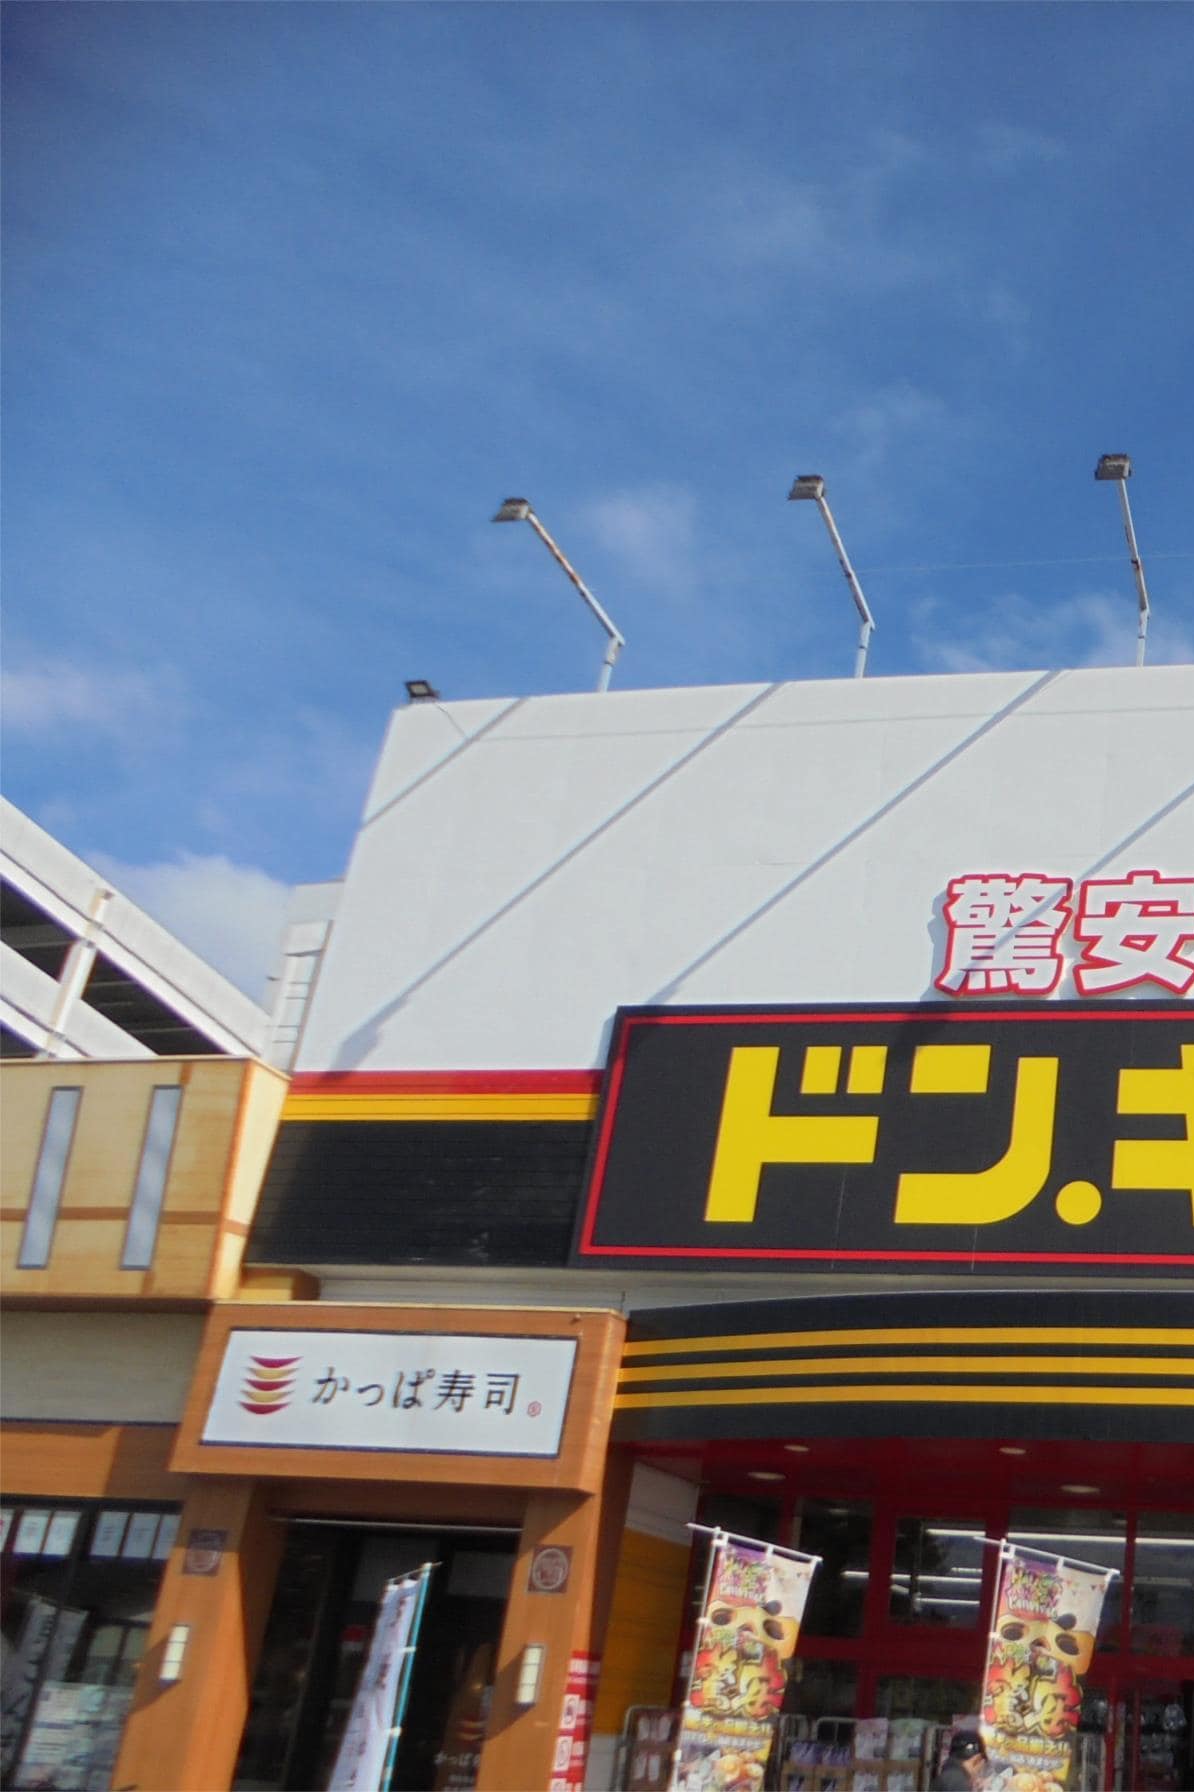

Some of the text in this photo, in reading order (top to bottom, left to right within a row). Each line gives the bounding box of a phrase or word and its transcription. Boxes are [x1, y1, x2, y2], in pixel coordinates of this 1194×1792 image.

[311, 1366, 521, 1415] かっぱ寿司
